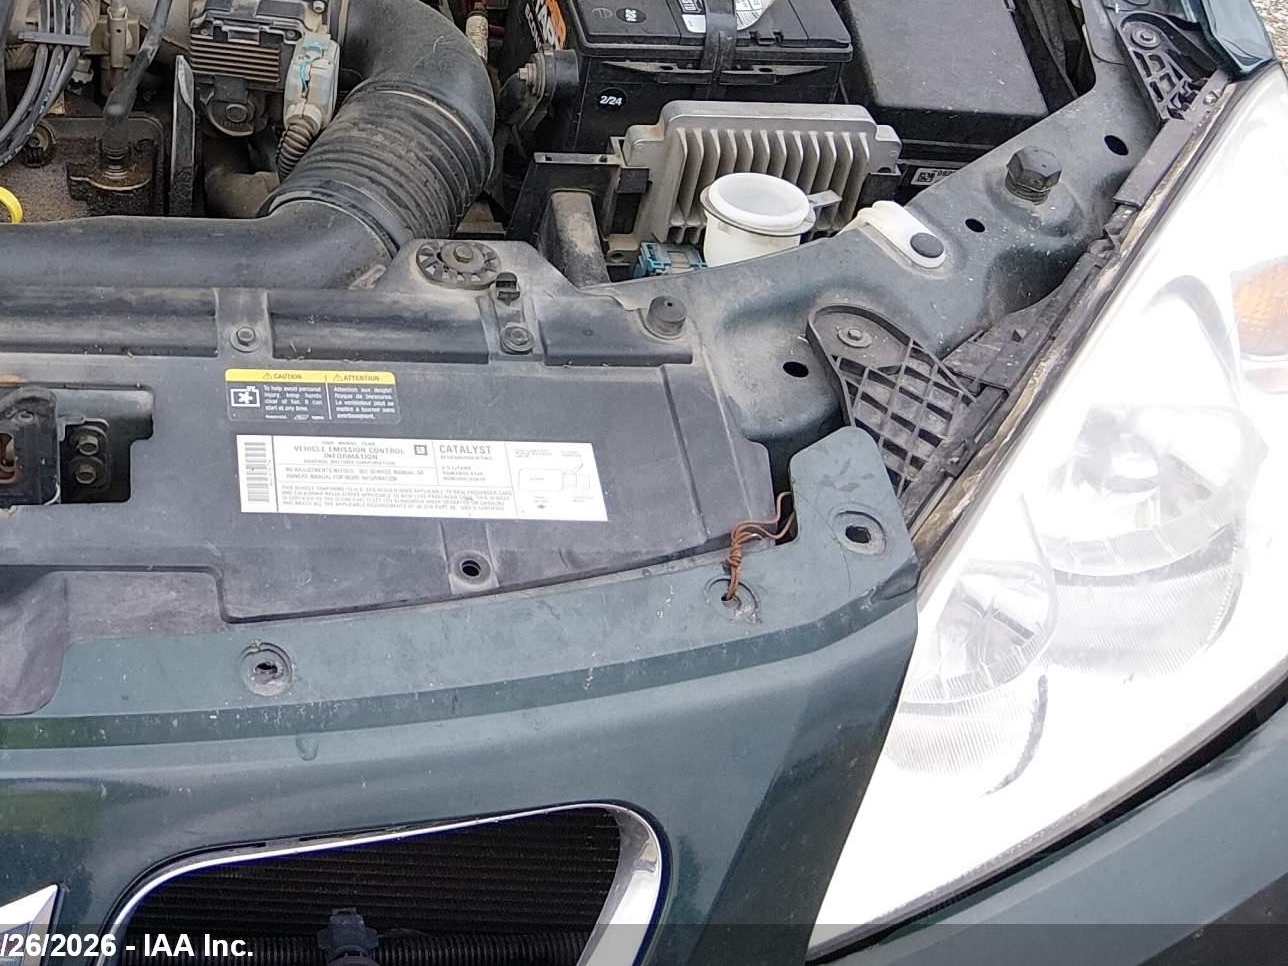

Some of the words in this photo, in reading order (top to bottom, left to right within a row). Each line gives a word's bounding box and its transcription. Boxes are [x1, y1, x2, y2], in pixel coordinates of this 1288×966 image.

[599, 95, 623, 106] 2/24
[294, 445, 326, 453] VEHICLE
[328, 445, 367, 454] EMISSION
[368, 446, 406, 455] CONTROL
[439, 444, 492, 455] CATALYST
[323, 453, 379, 461] INFORMATION
